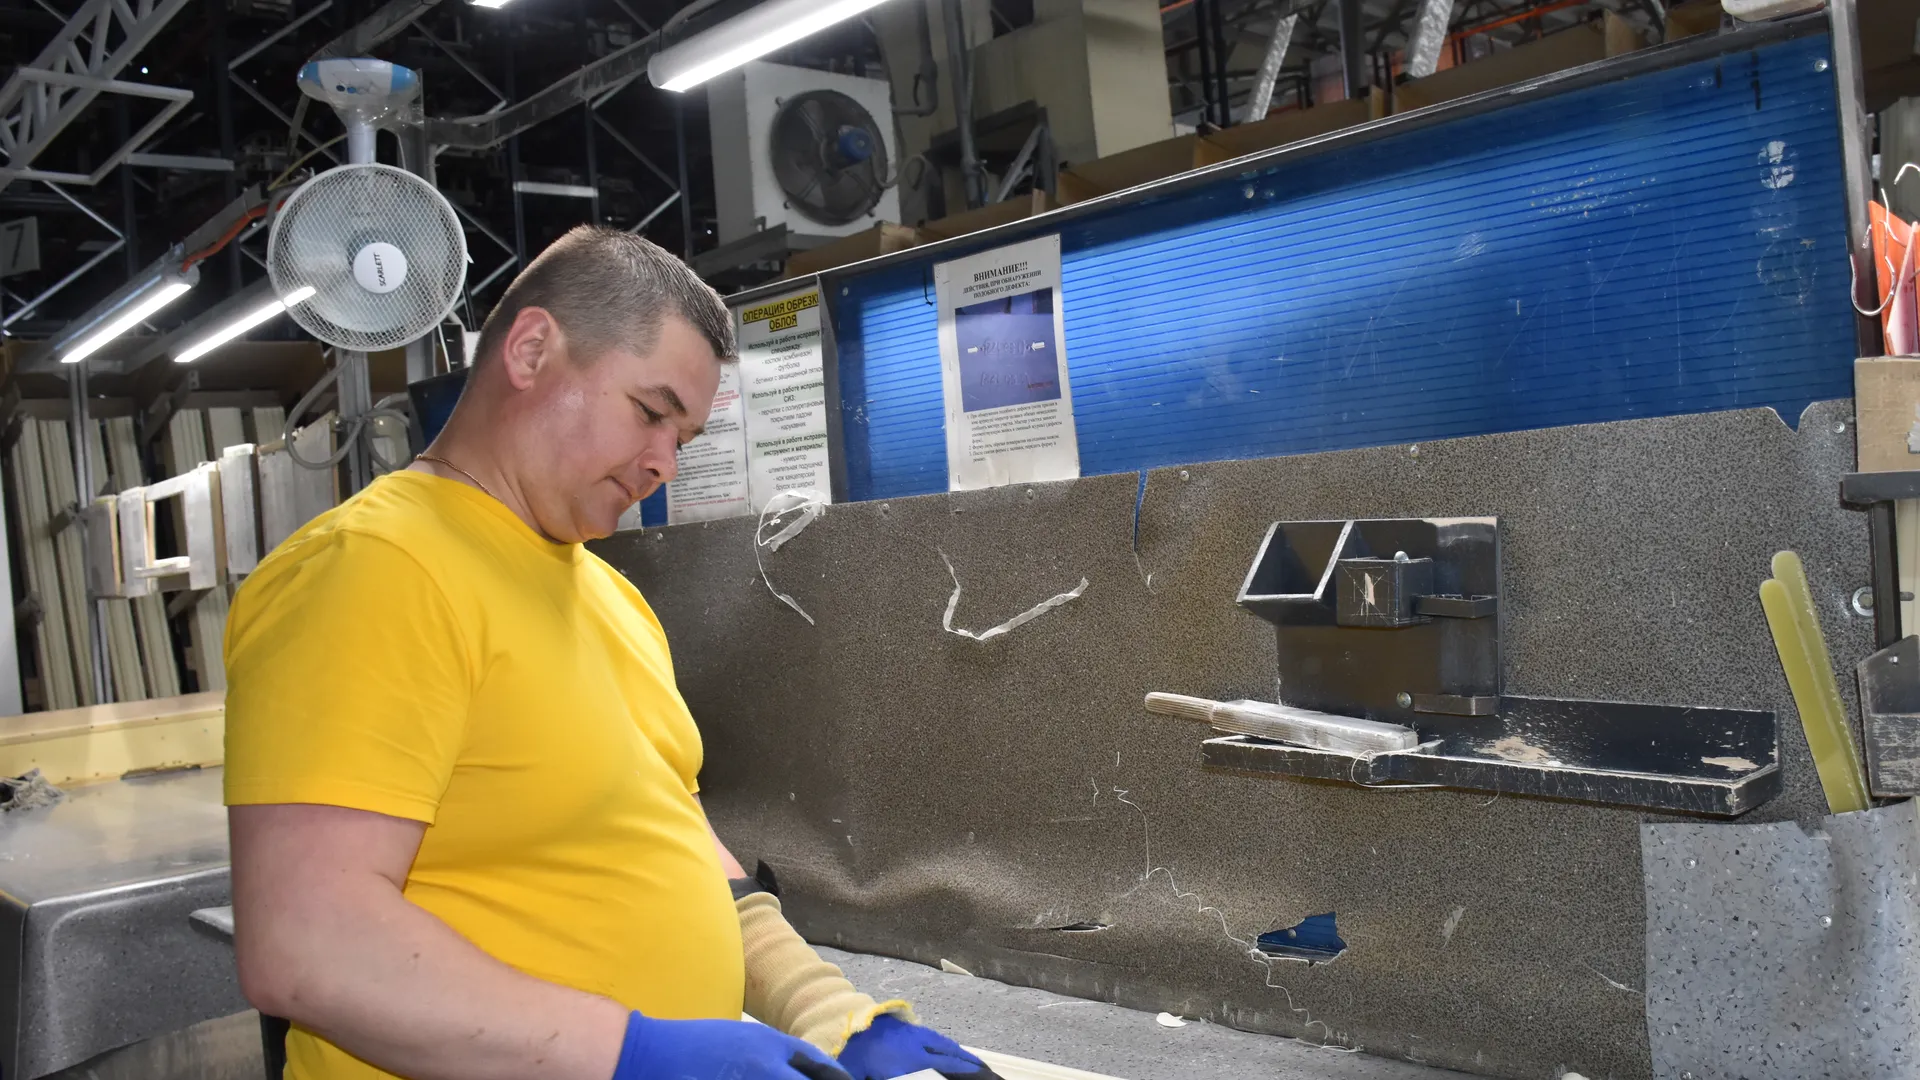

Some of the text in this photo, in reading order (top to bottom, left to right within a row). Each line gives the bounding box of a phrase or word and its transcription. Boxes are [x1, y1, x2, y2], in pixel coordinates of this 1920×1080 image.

[373, 252, 387, 287] SCARLETT
[973, 261, 1028, 282] ВНИМАНИЕ!!!
[1001, 270, 1042, 284] ОБНАРУЖЕНИИ
[742, 303, 785, 322] ОПЕРАЦИЯ
[769, 314, 797, 330] ОБЛОЯ
[748, 339, 774, 351] Используй
[780, 335, 796, 345] работе
[797, 329, 820, 340] исправну
[752, 388, 777, 399] Используй
[782, 384, 800, 394] работе
[756, 438, 781, 449] Используй
[786, 435, 803, 445] работе
